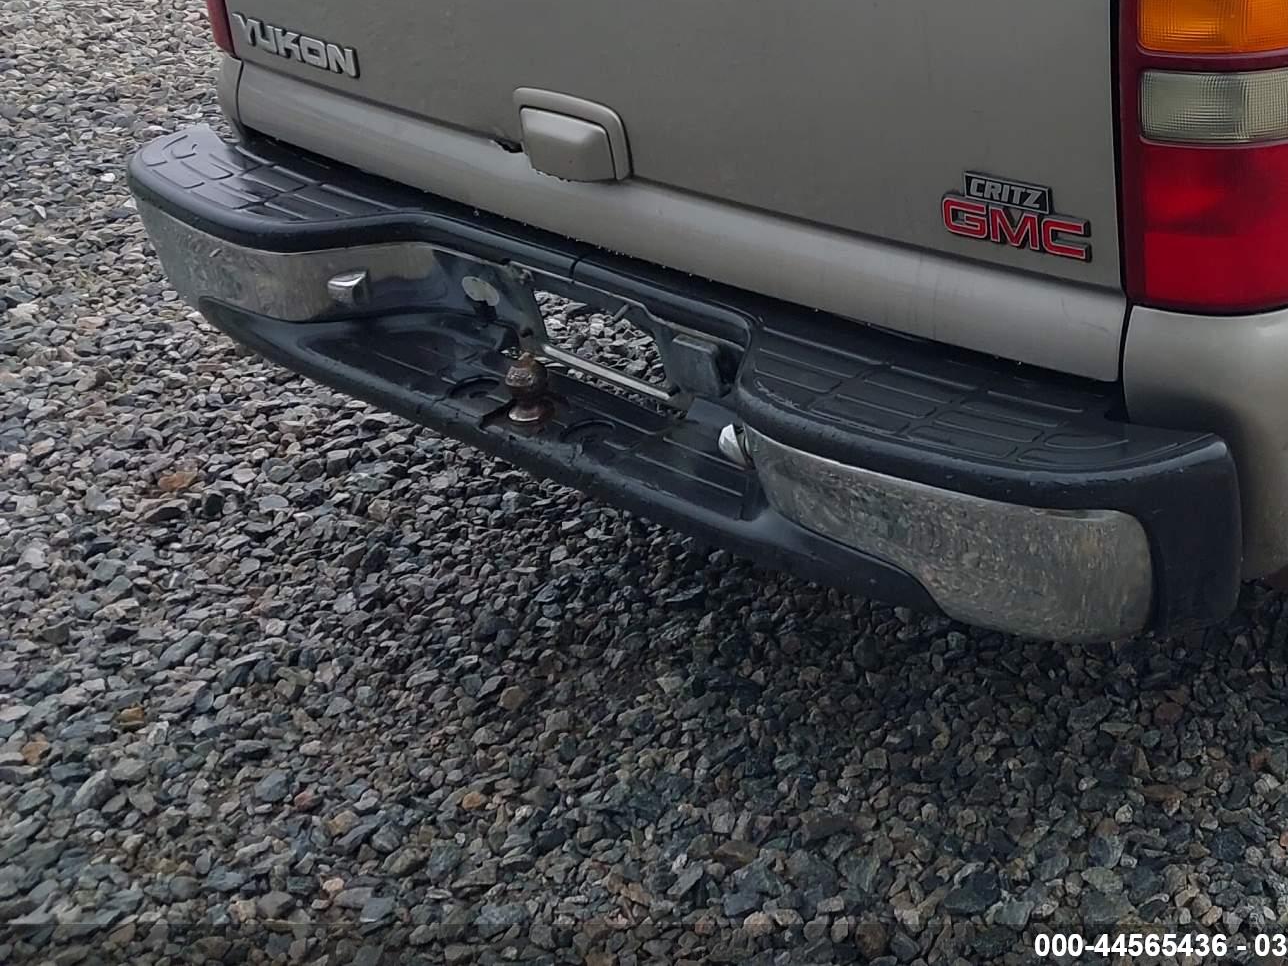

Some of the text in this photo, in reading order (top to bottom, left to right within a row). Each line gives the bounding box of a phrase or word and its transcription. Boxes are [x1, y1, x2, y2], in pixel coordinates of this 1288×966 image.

[231, 12, 357, 77] YUKON
[968, 177, 1043, 209] CRITZ
[942, 195, 1087, 260] GMC
